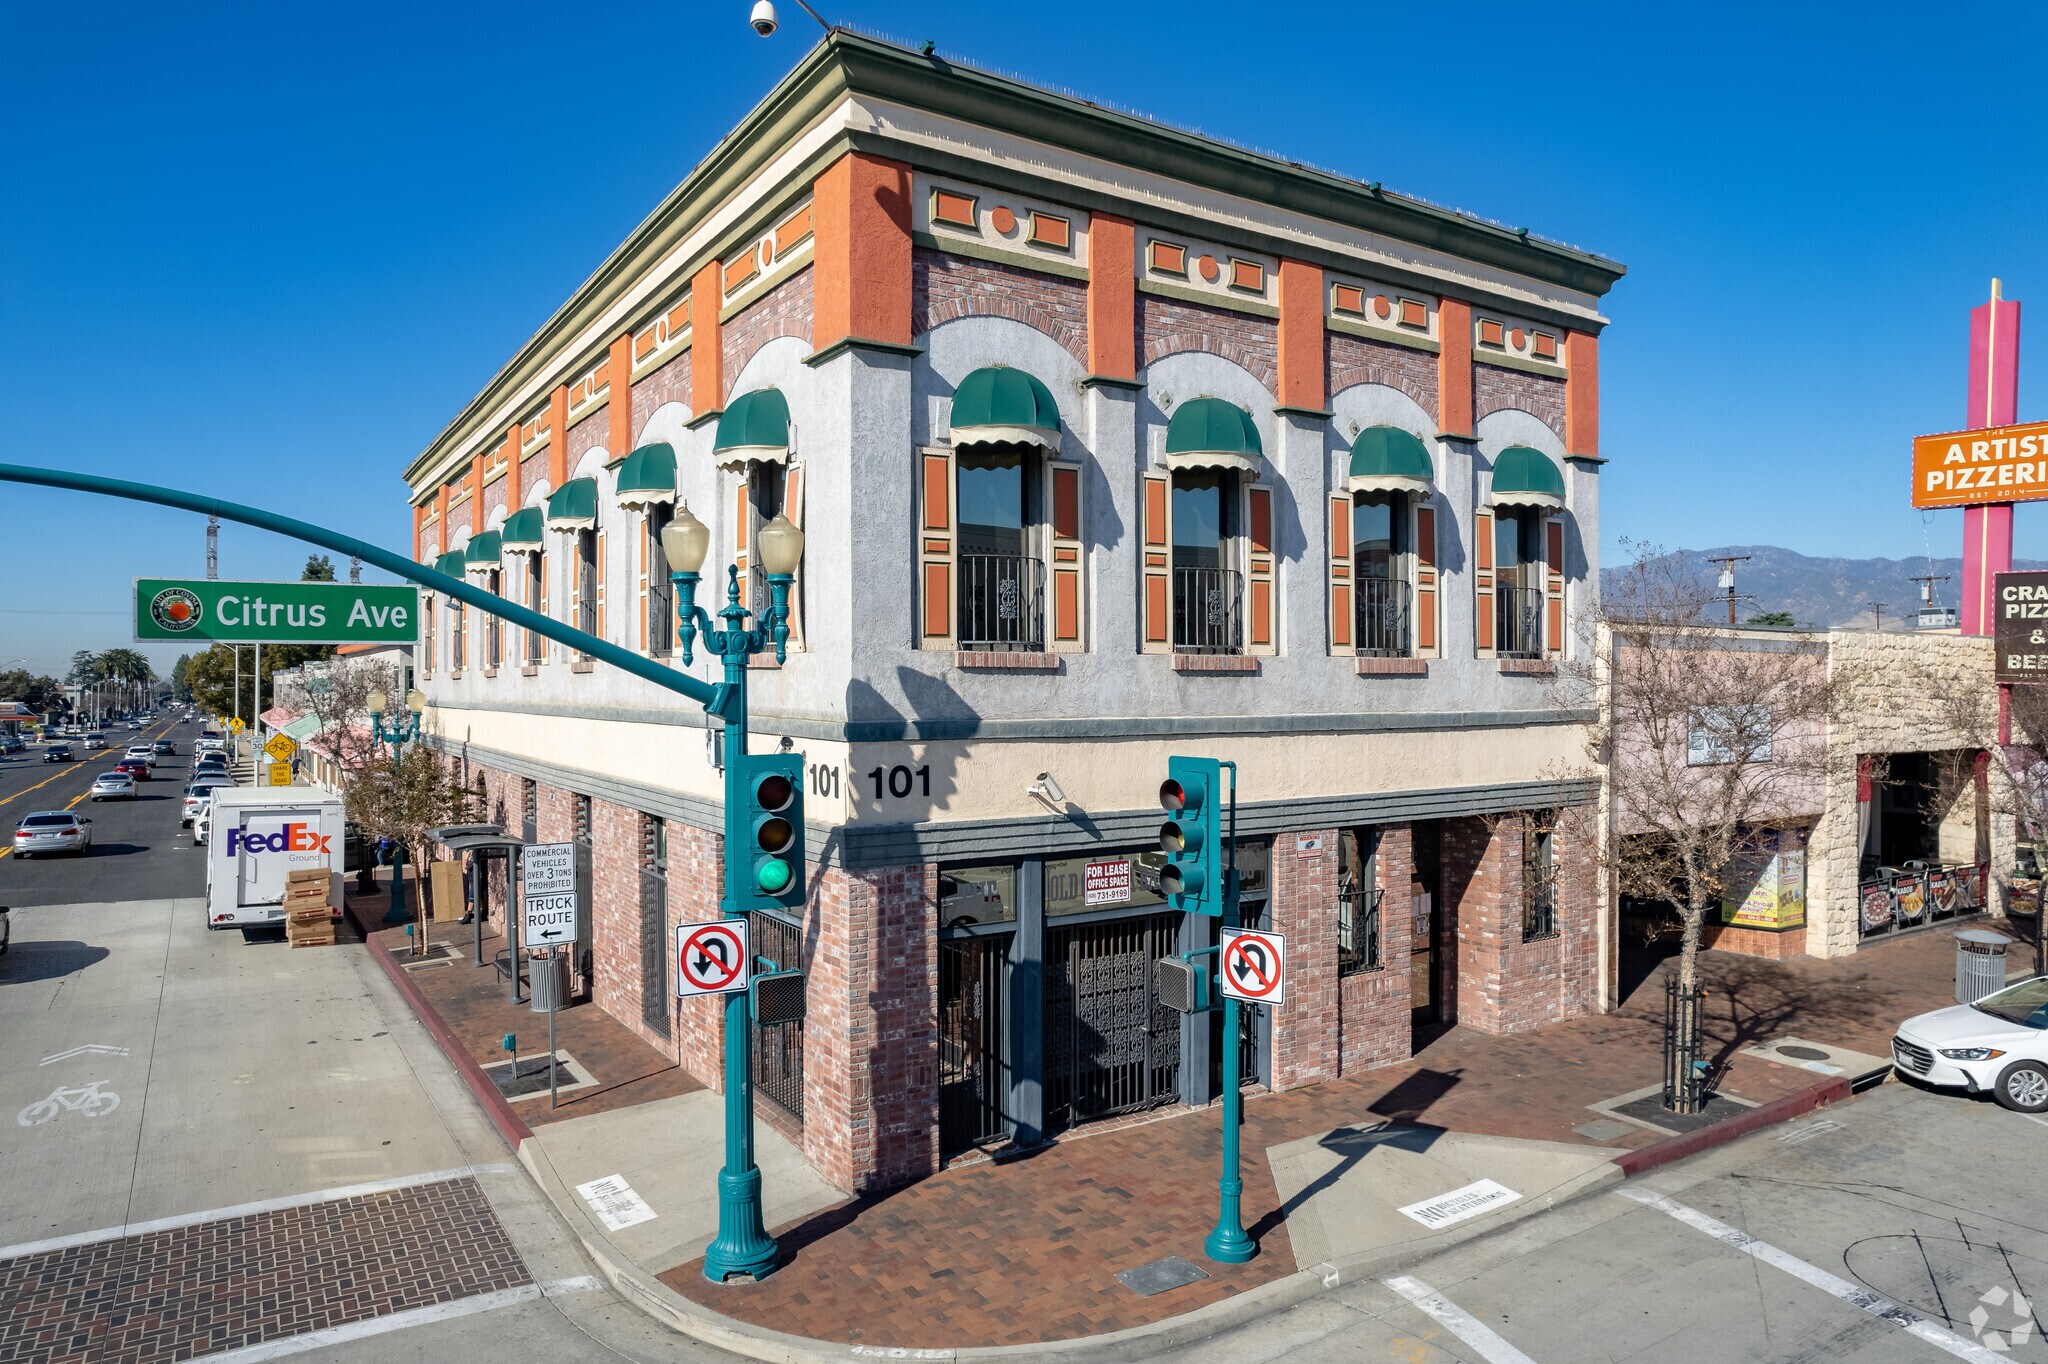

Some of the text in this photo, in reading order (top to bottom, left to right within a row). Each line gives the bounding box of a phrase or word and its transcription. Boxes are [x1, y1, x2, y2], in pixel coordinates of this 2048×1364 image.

[1926, 461, 2048, 492] PIZZERI
[216, 595, 408, 628] Citrus Ave
[2030, 629, 2046, 644] &
[810, 764, 839, 799] 101
[868, 765, 930, 799] 101
[227, 823, 332, 857] FedEx
[288, 854, 320, 862] Ground
[526, 848, 572, 858] COMMERCIAL
[532, 858, 567, 868] VEHICLES
[1087, 863, 1128, 878] FOR LEASE
[527, 868, 572, 879] OVER 3 TONS
[528, 879, 571, 890] PROHIBITED
[1050, 872, 1078, 902] OLD
[1088, 878, 1108, 889] OFFICE
[1109, 875, 1127, 887] SPACE
[1097, 889, 1128, 900] 731-9199
[528, 897, 573, 911] TRUCK
[528, 912, 573, 926] ROUTE
[1436, 1192, 1479, 1210] BICYCLES
[1414, 1206, 1450, 1226] NO
